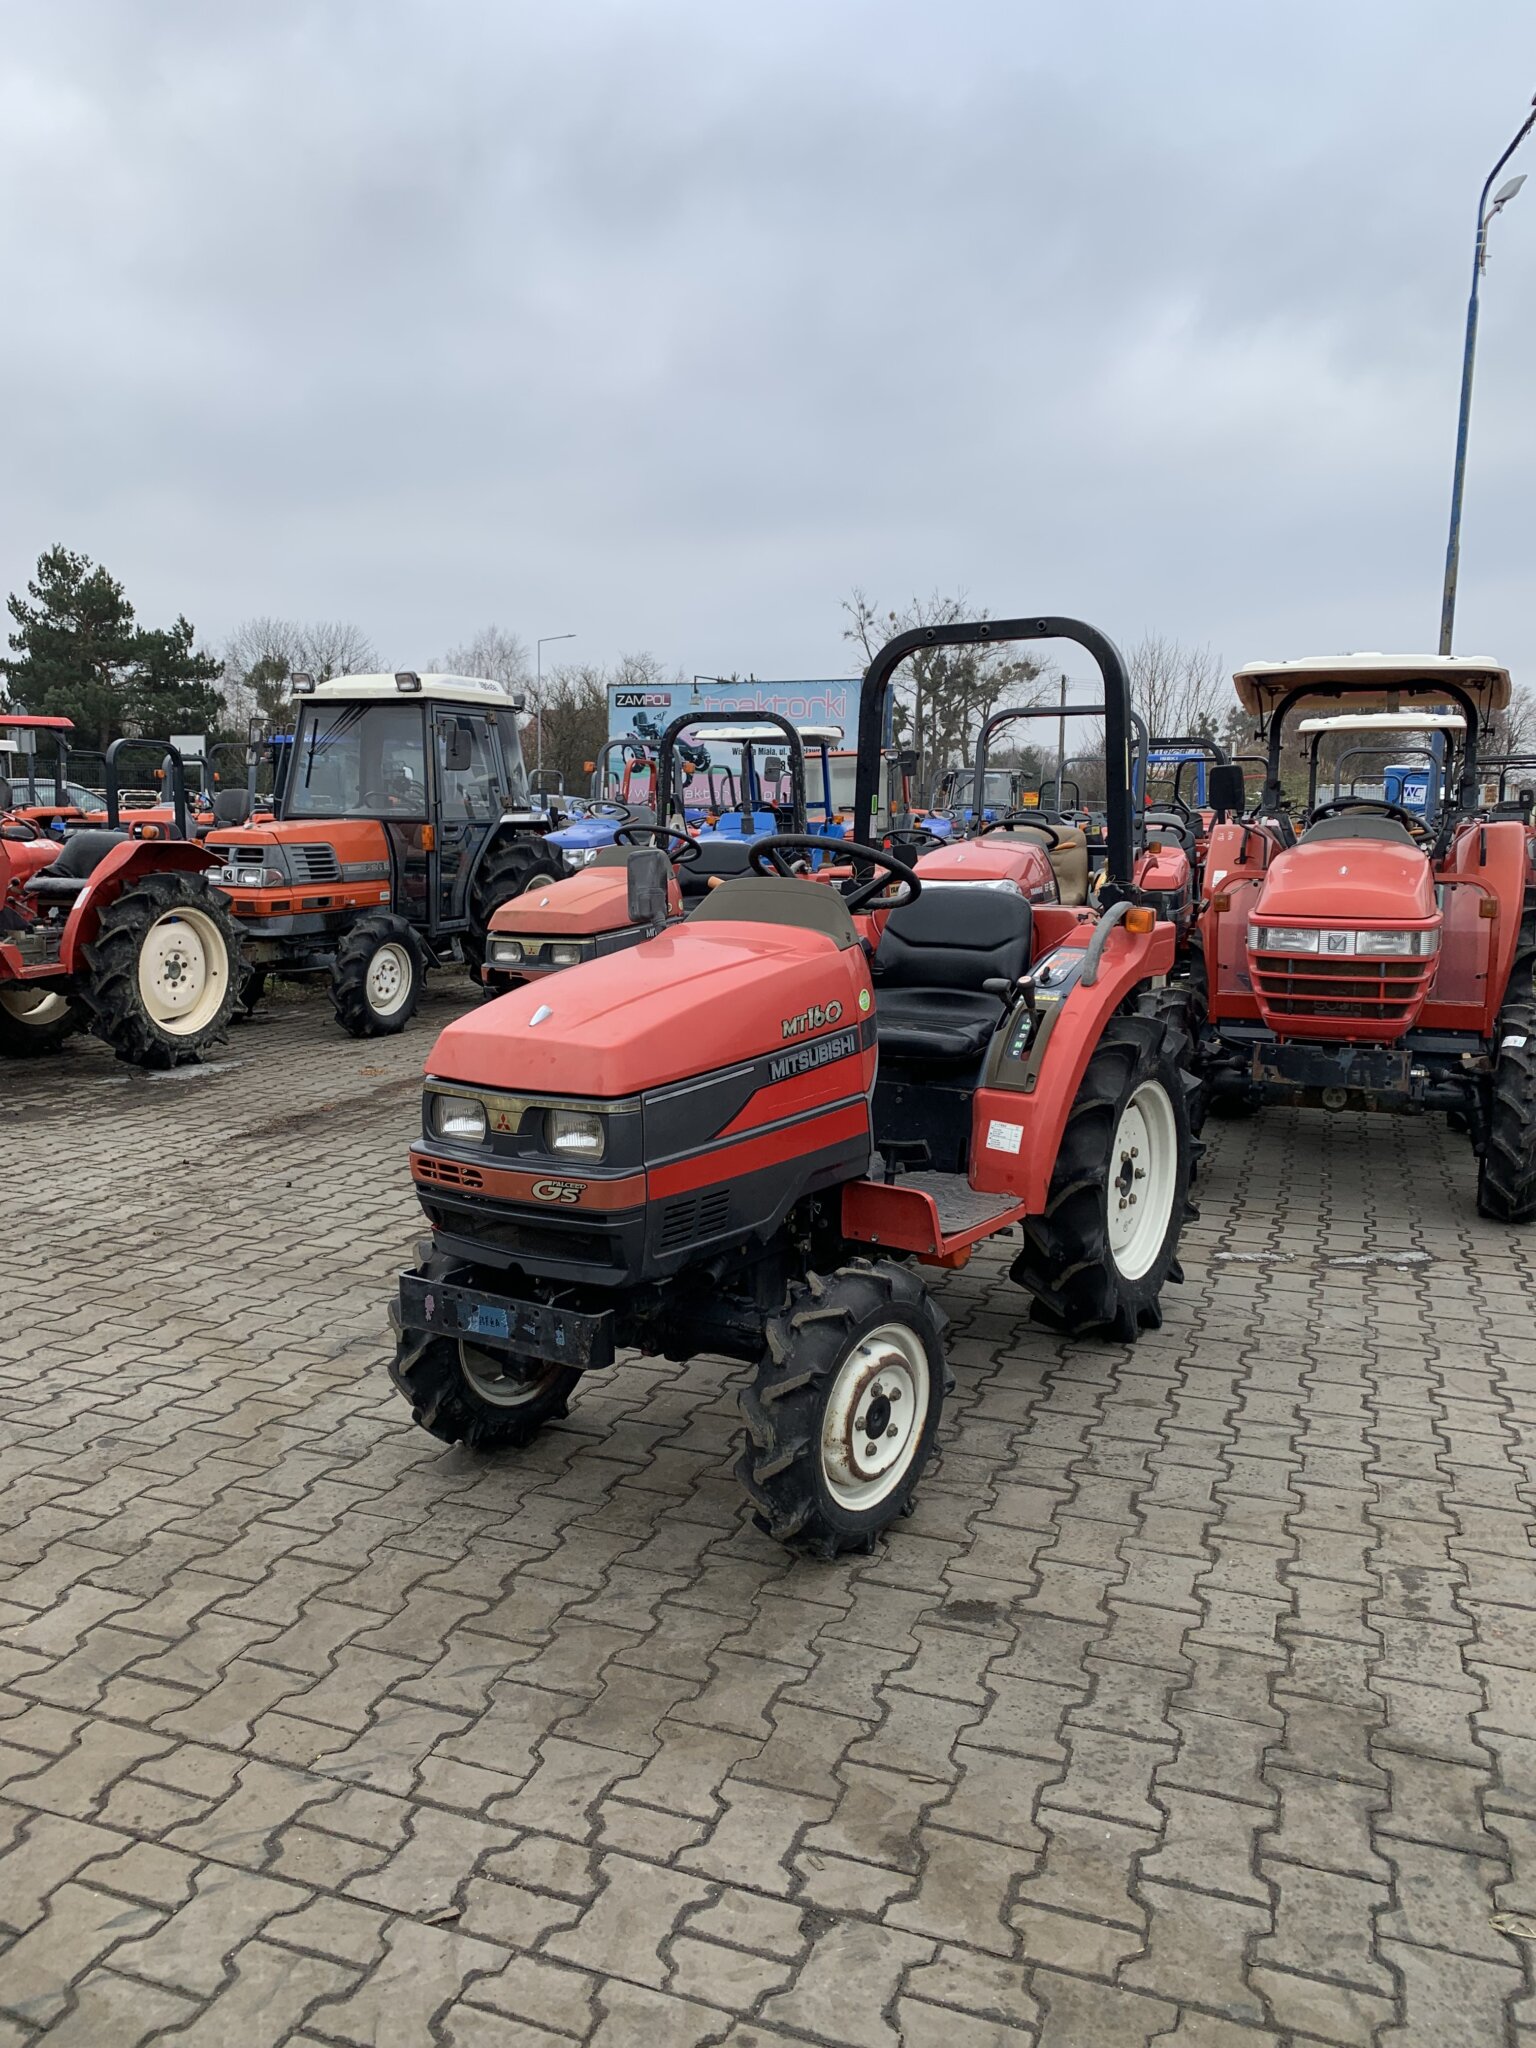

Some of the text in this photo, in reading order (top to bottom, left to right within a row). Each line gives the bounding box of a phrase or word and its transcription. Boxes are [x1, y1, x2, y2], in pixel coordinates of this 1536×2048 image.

[616, 695, 670, 706] ZAMPOL
[782, 1000, 843, 1039] MT160
[770, 1033, 856, 1081] MITSUBISHI
